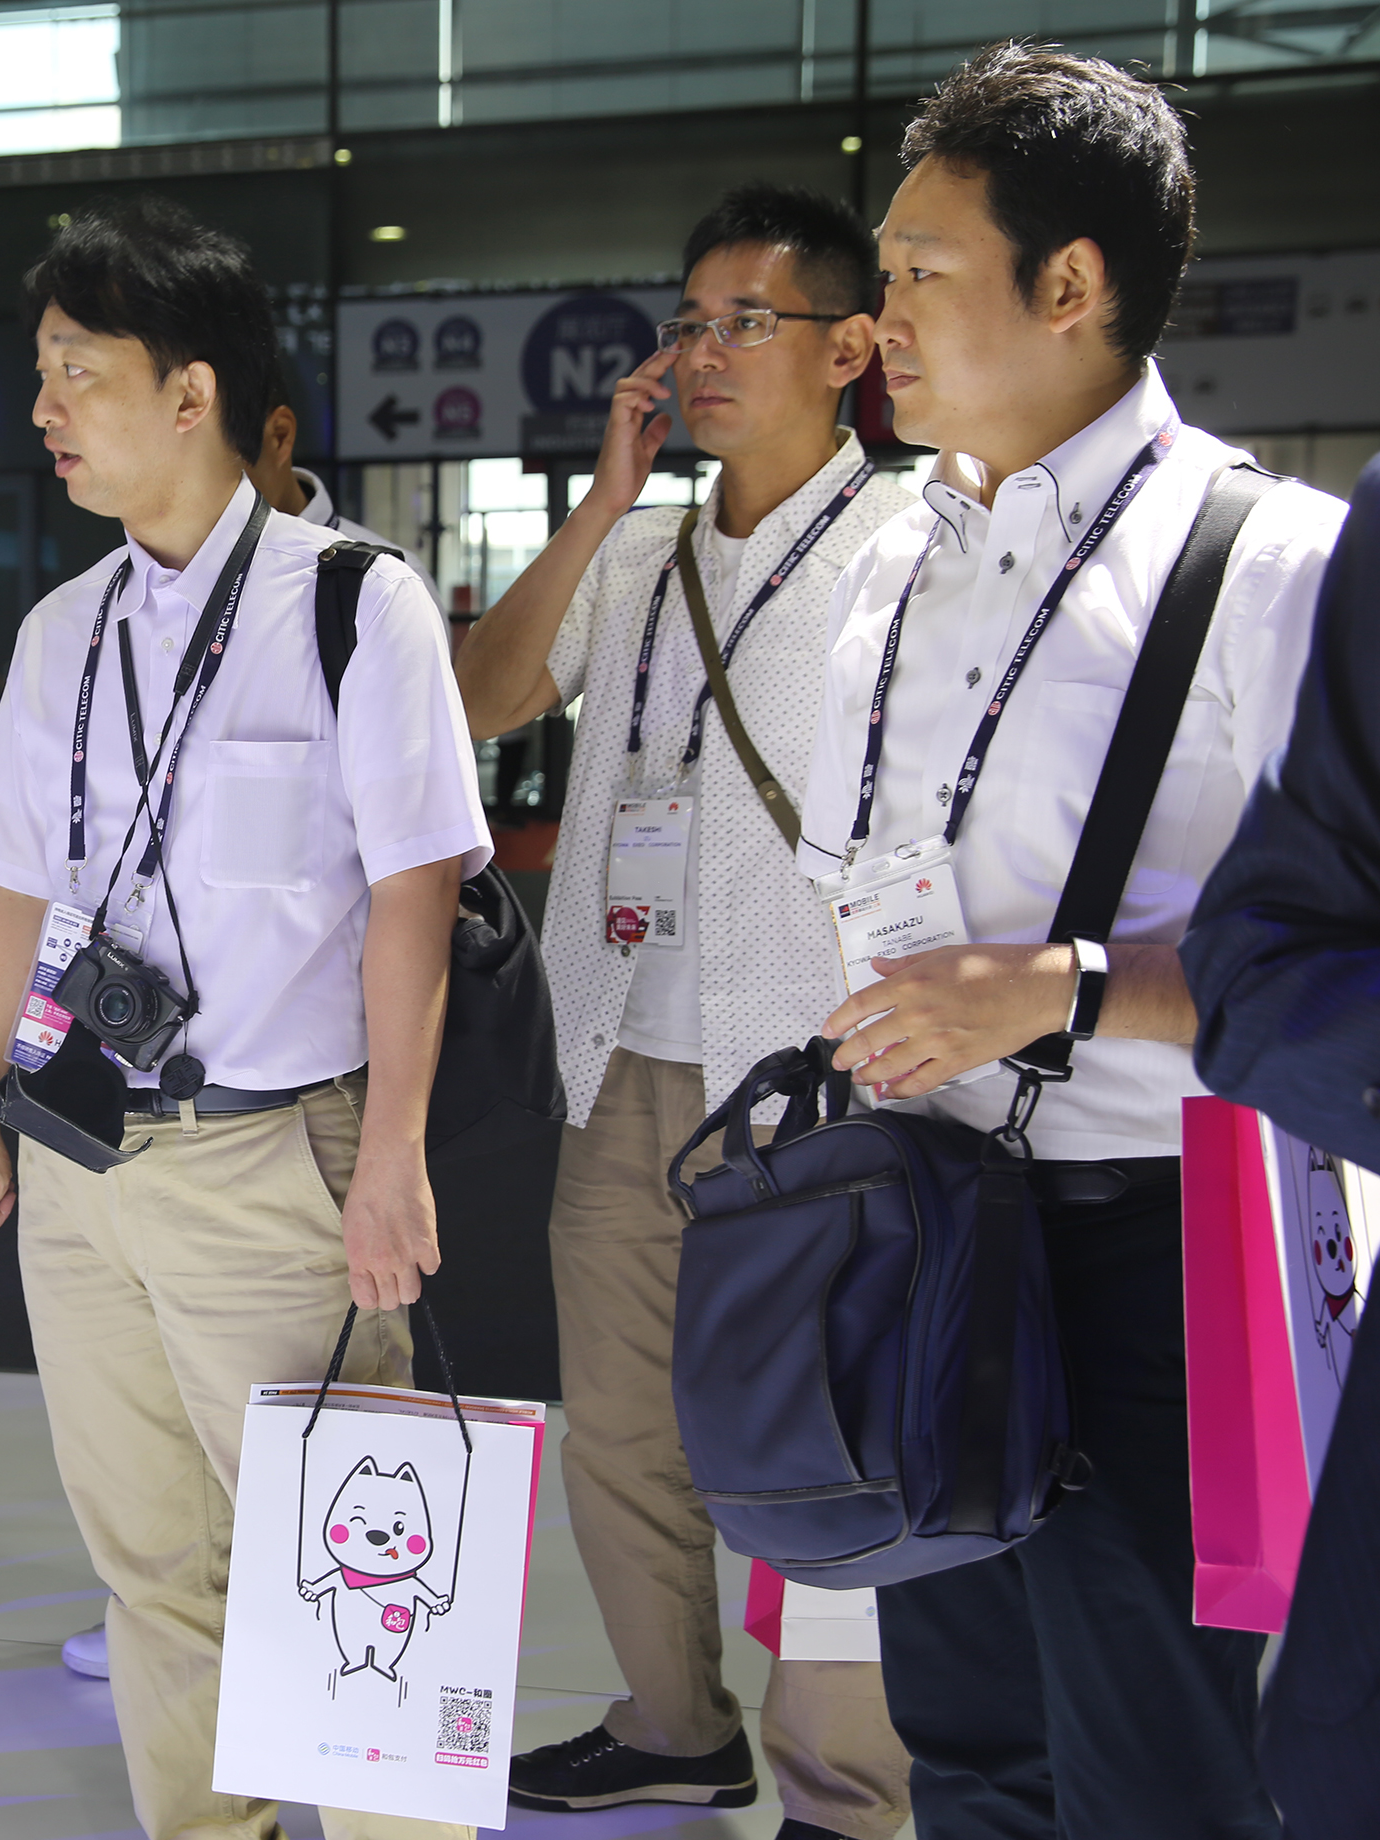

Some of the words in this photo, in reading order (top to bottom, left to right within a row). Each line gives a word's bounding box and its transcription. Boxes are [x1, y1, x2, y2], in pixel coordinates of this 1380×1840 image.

[548, 343, 635, 400] N2
[1076, 525, 1104, 557] CITIC
[1100, 473, 1143, 525] TELECOM
[216, 618, 231, 643] CITIC
[224, 572, 243, 617] TELECOM
[874, 677, 888, 710] CITIC
[882, 618, 901, 677] TELECOM
[996, 666, 1018, 700] CITIC
[1014, 607, 1050, 665] TELECOM
[79, 675, 91, 720] TELECOM
[75, 723, 85, 750] CITIC
[130, 712, 138, 743] LUMIX
[850, 893, 880, 907] MOBILE
[867, 915, 924, 940] MASAKAZU
[882, 933, 913, 947] TANABE
[902, 930, 955, 951] CORPORATION
[107, 951, 125, 968] LUMIX
[332, 1744, 359, 1754] 中国移动
